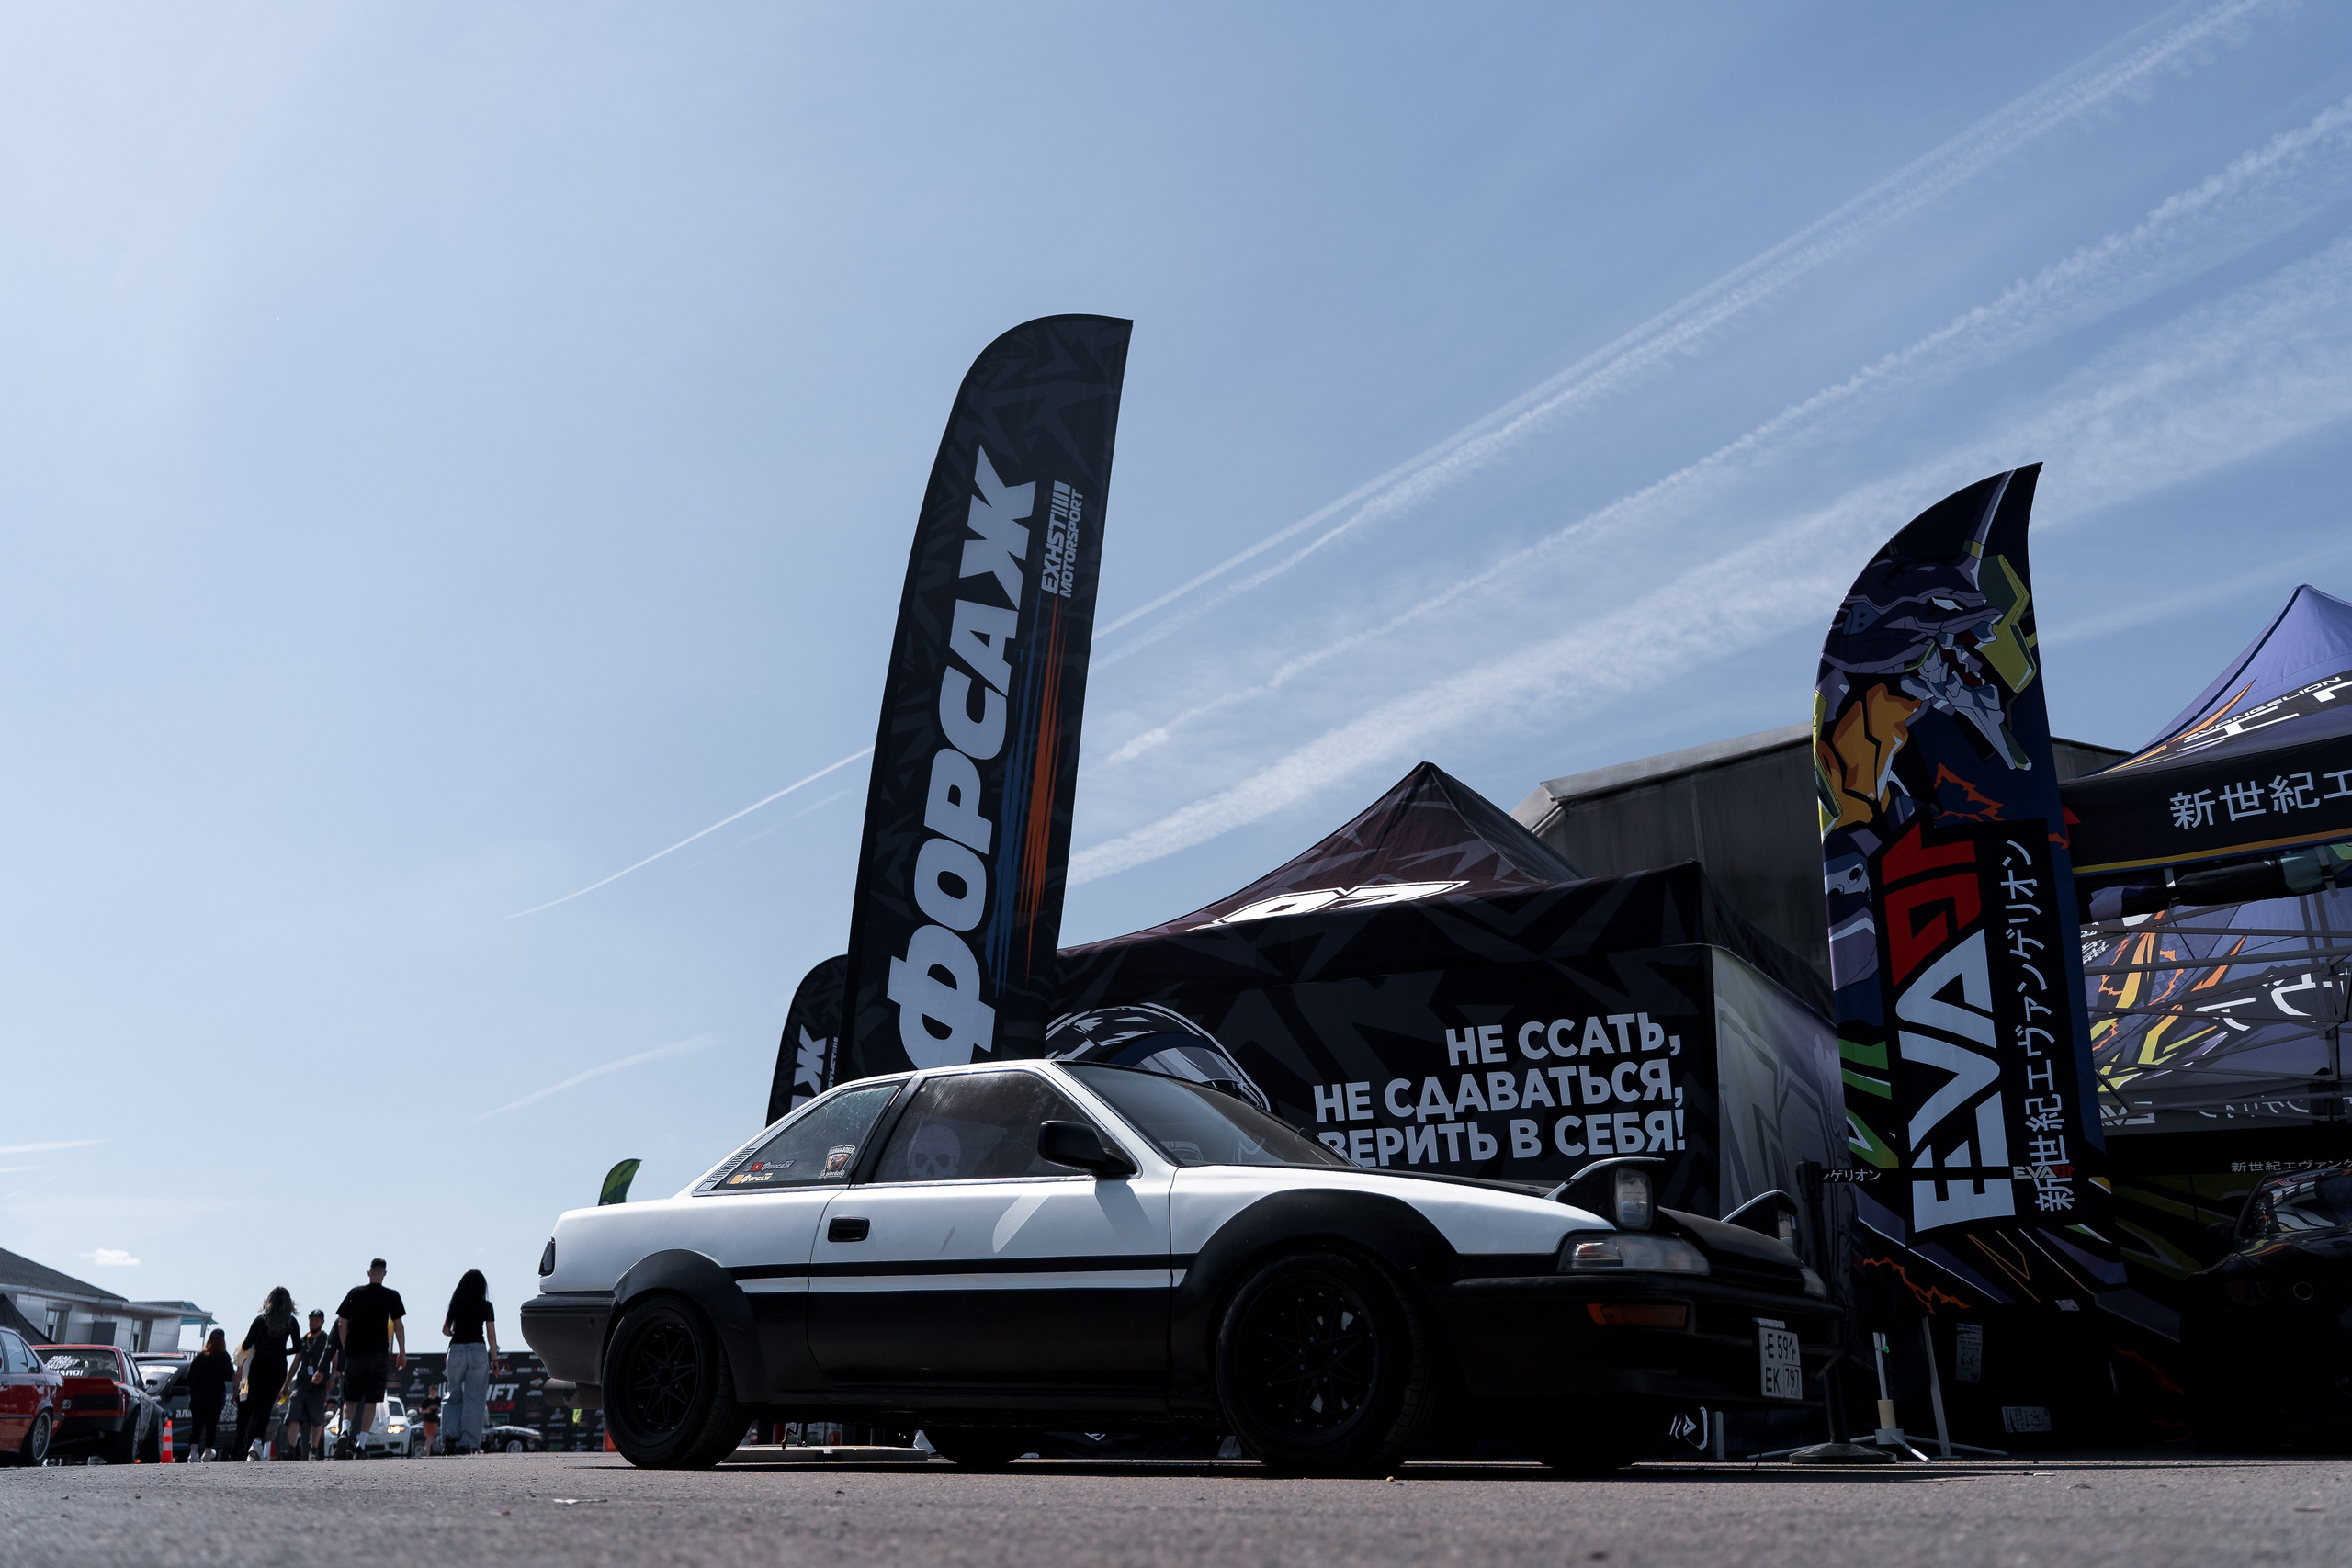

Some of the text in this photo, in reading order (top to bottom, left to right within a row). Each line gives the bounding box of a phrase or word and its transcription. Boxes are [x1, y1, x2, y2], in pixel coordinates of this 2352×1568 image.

[1060, 489, 1083, 598] MOTORSPORT
[887, 444, 1036, 1069] ФОРСАЖ
[1445, 1011, 1682, 1066] НЕ ССАТЬ,
[2000, 840, 2075, 1212] 新世紀エヴァンゲリオン
[1314, 1058, 1683, 1122] НЕ СДАВАТЬСЯ,
[1510, 1118, 1542, 1159] В
[1555, 1109, 1685, 1155] СЕБЯ!
[1785, 1368, 1799, 1388] 797
